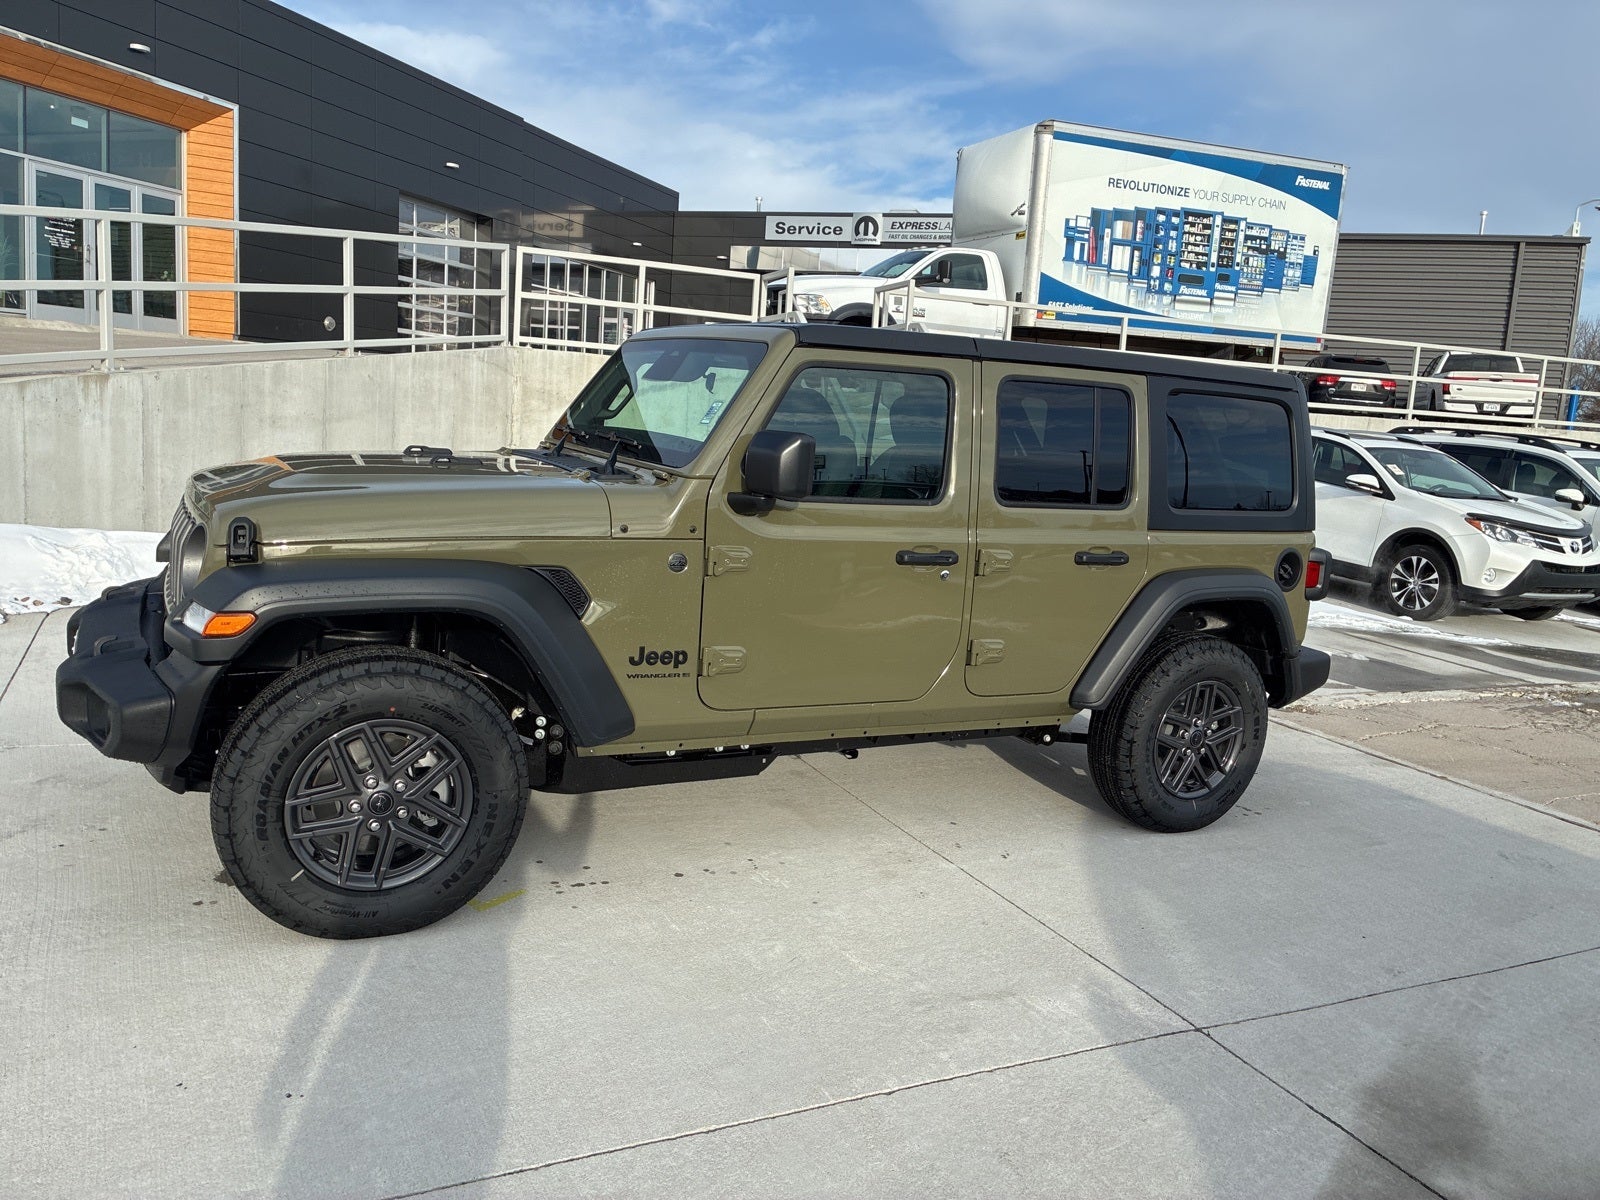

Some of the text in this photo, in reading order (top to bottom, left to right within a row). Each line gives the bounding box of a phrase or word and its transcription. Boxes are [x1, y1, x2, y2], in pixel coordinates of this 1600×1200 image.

[1108, 177, 1287, 211] REVOLUTIONIZE YOUR SUPPLY CHAIN
[775, 221, 843, 235] Service
[890, 221, 952, 230] EXPRESSLA
[628, 646, 688, 668] Jeep
[255, 747, 289, 841] ROADIAN
[442, 803, 498, 890] NEXEN
